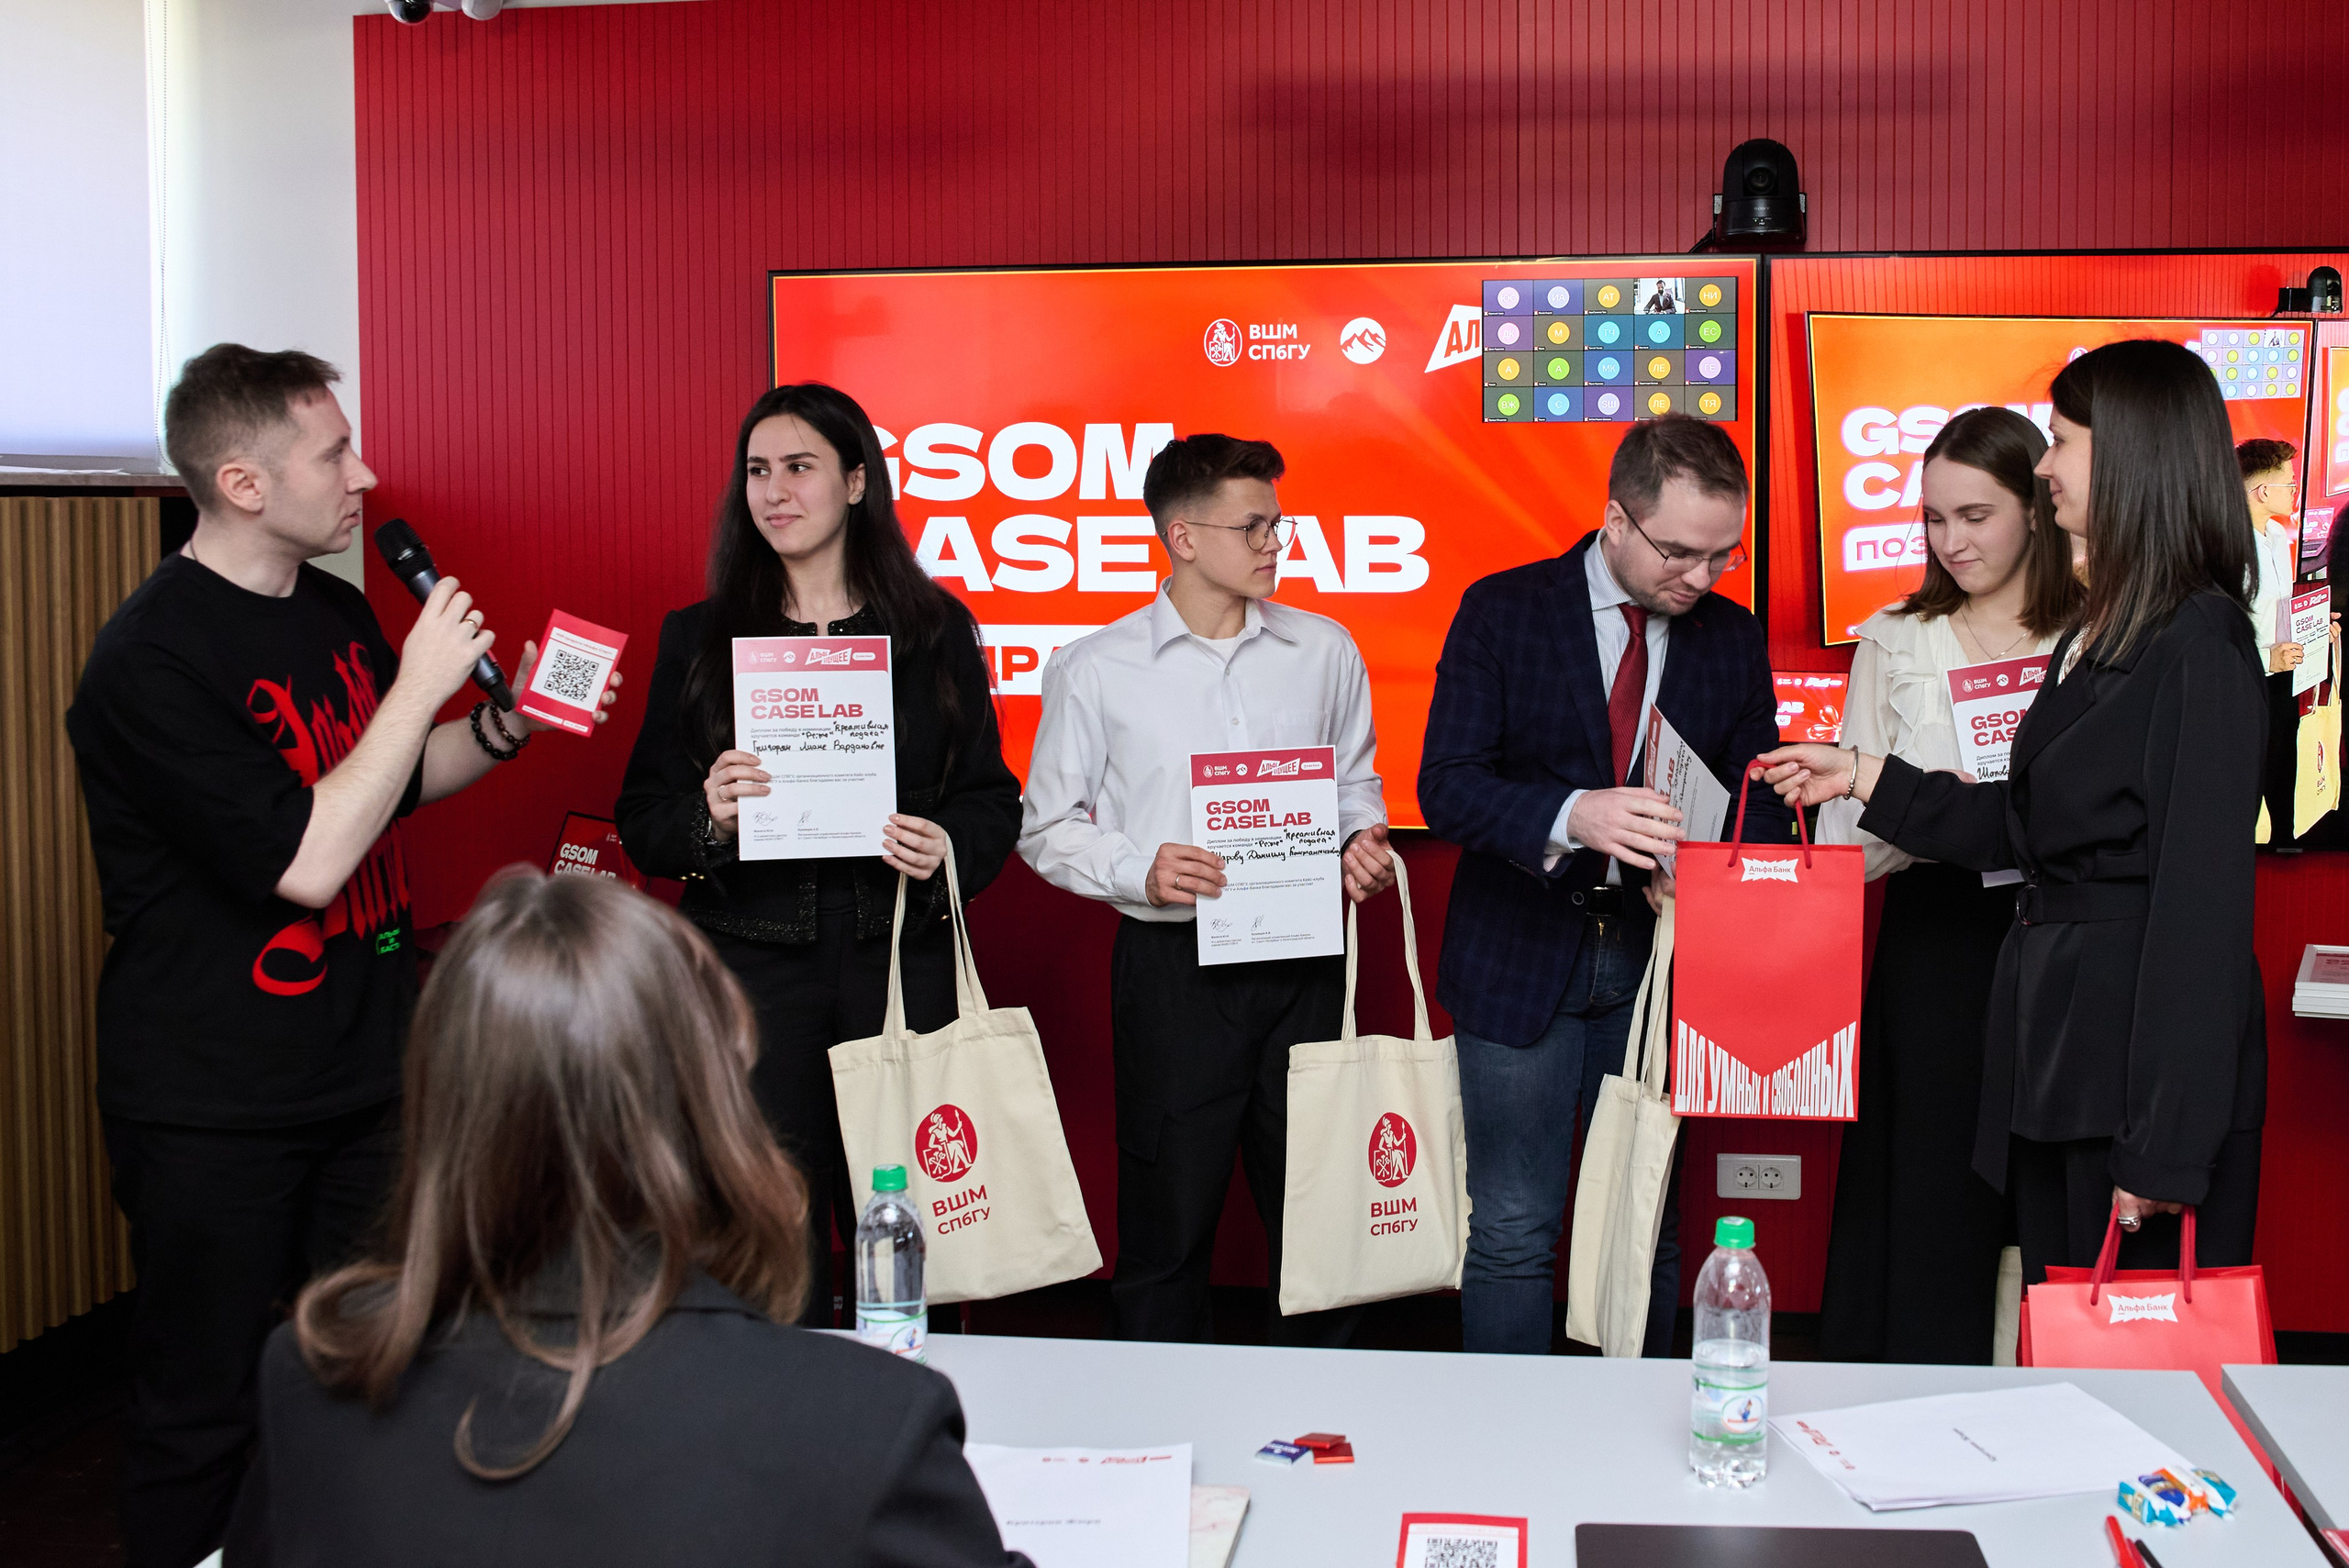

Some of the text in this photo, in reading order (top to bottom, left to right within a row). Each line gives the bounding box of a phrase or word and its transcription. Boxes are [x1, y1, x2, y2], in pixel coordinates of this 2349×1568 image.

[1602, 293, 1615, 301] АТ
[1249, 324, 1297, 339] ВШМ
[1502, 329, 1515, 339] ДК
[1554, 329, 1563, 338] М
[1602, 328, 1615, 337] ТЧ
[1655, 328, 1663, 336] А
[1703, 328, 1718, 336] ЕС
[1248, 343, 1310, 361] СПбГУ
[1505, 365, 1512, 373] А
[1602, 364, 1616, 373] МК
[1653, 363, 1665, 373] ЛЕ
[1501, 401, 1517, 409] ВЖ
[1653, 400, 1665, 408] ЛЕ
[1704, 399, 1717, 407] ТЯ
[915, 514, 1430, 593] ASE AB
[751, 688, 819, 703] GSOM
[751, 704, 863, 719] CASE LAB
[1206, 798, 1271, 815] GSOM
[1207, 812, 1312, 831] CASE LAB
[560, 842, 599, 865] GSOM
[1749, 865, 1791, 874] Альфа Банк
[1675, 1018, 1857, 1118] ДЛЯ УМНЫХ И СВОБОДНЫХ
[932, 1184, 988, 1218] ВШМ
[1370, 1196, 1418, 1218] ВШМ
[937, 1207, 991, 1235] СПбГУ
[1370, 1218, 1419, 1237] СПбГУ
[2118, 1303, 2168, 1315] Альфа Банк
